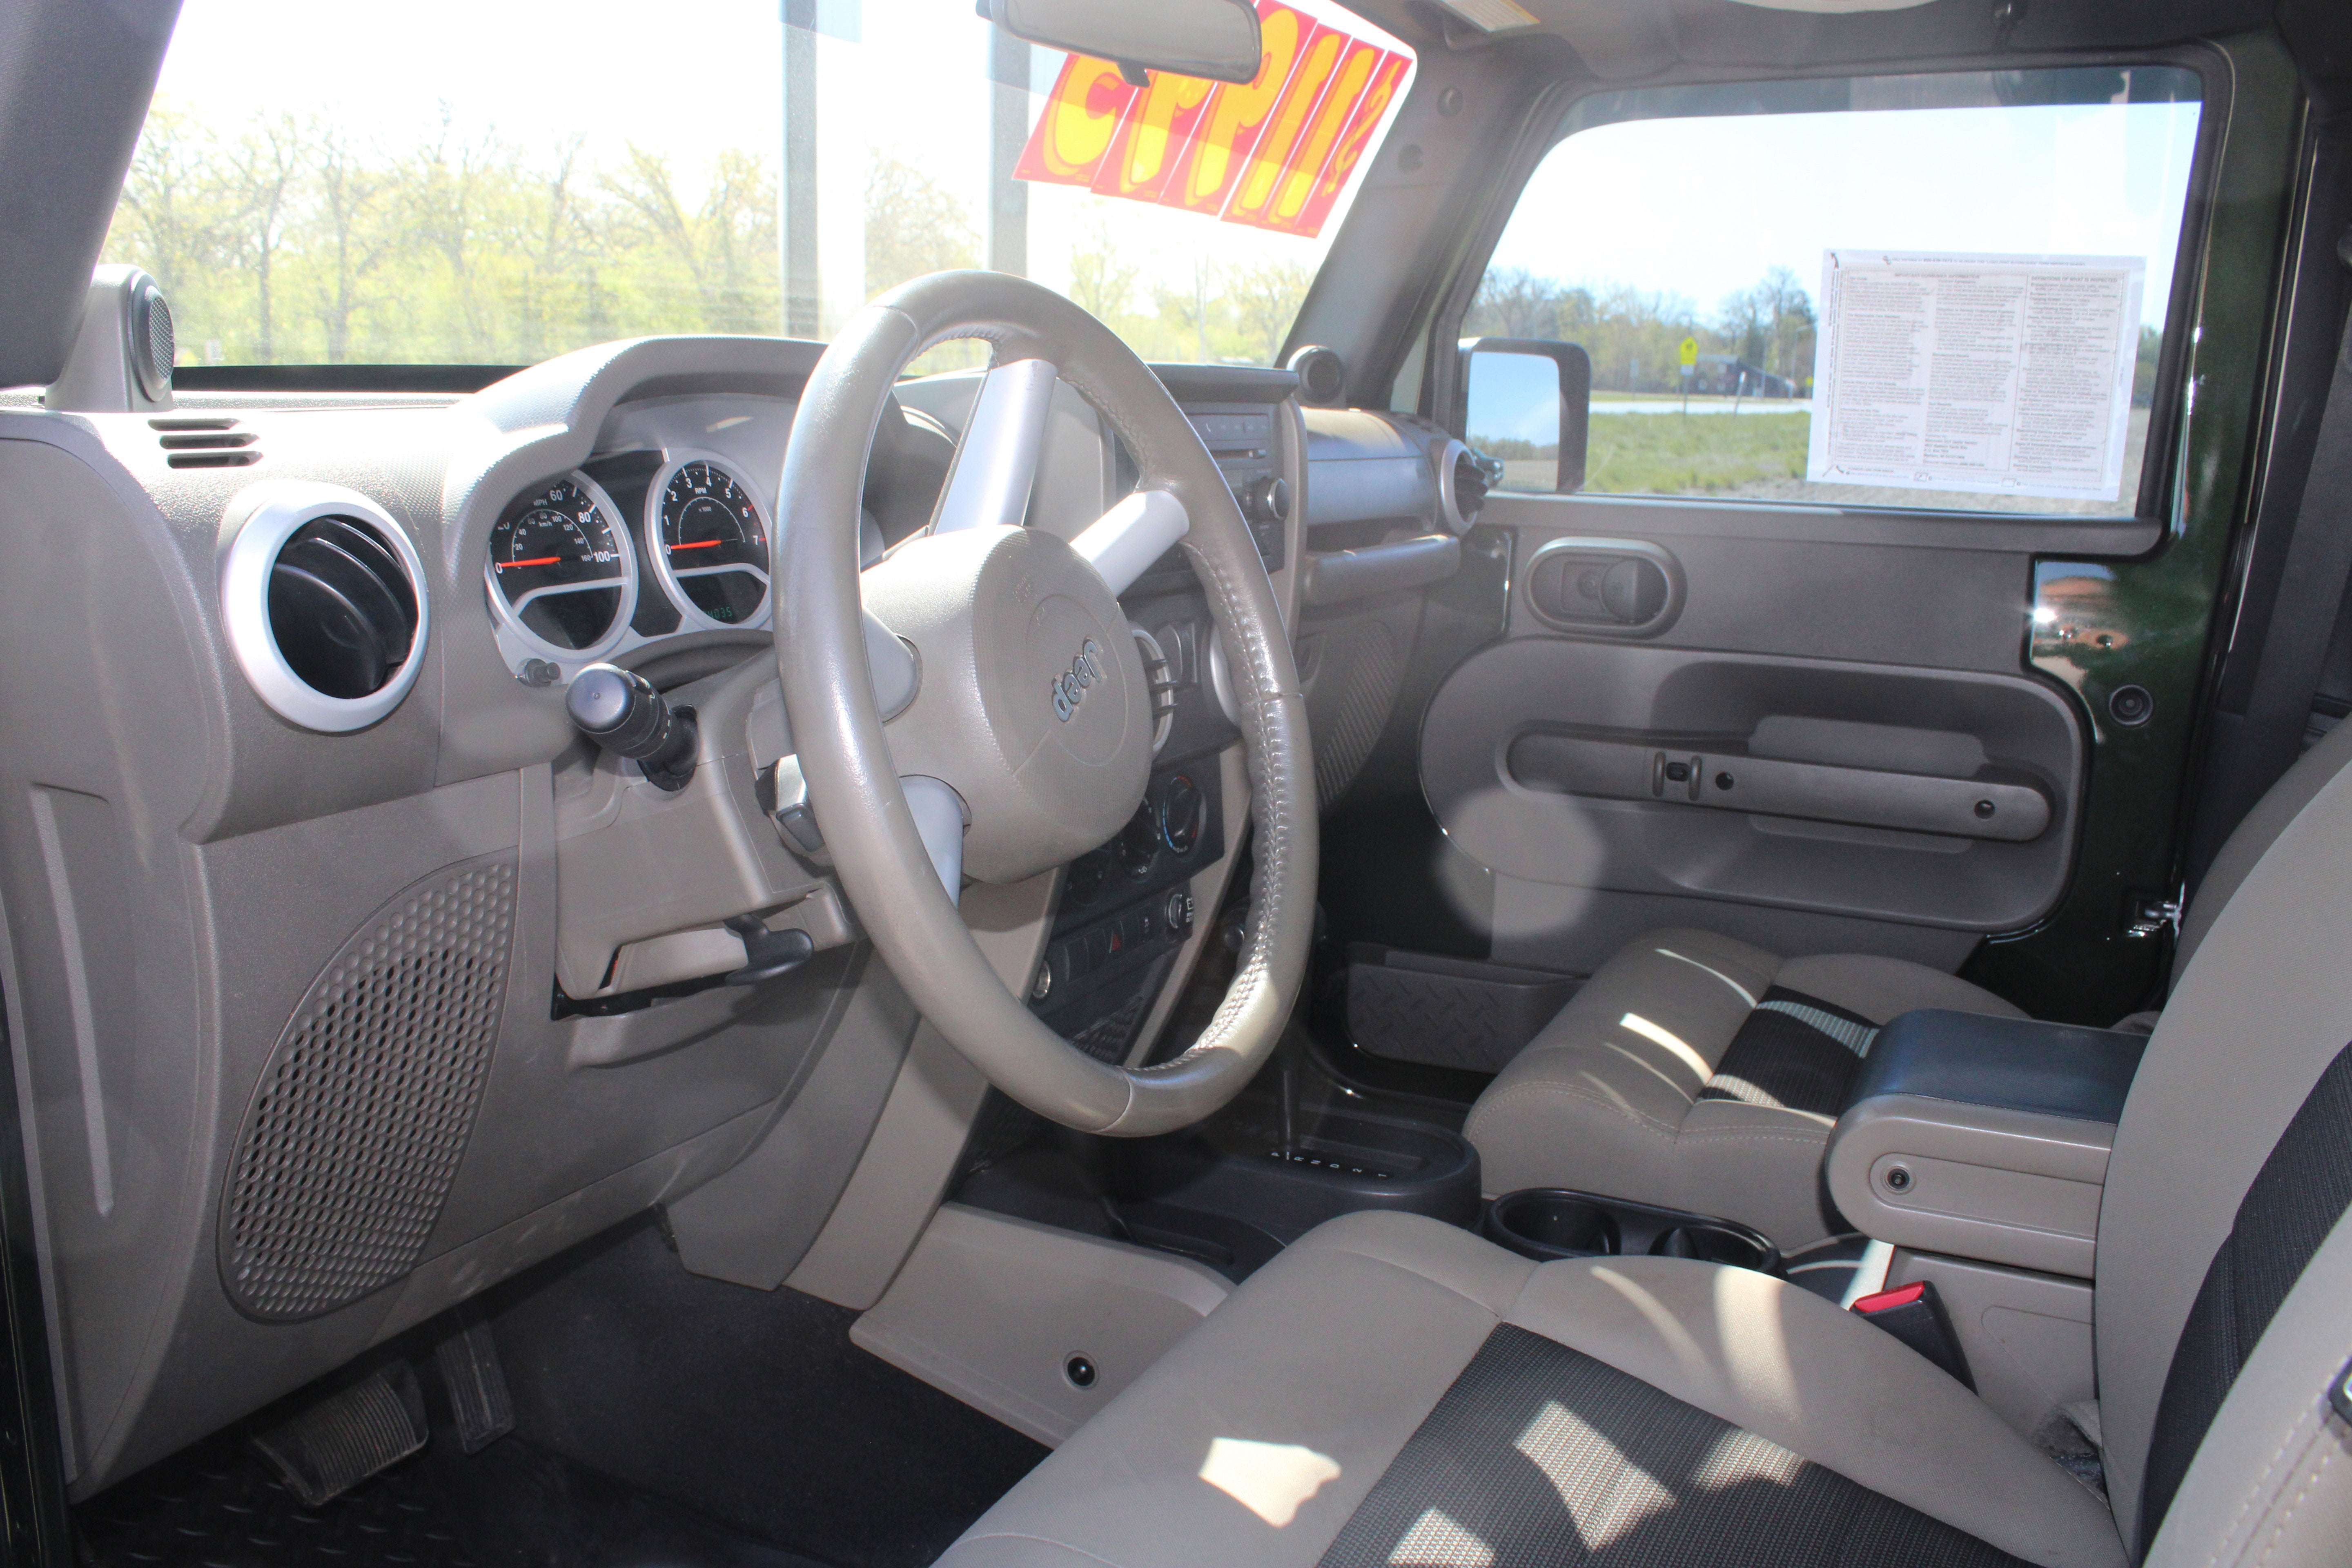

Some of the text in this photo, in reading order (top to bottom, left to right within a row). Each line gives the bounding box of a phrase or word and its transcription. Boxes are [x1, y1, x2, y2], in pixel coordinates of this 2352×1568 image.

[685, 477, 693, 488] 3
[706, 476, 712, 487] 4
[550, 490, 563, 501] 60
[671, 490, 678, 501] 2
[725, 488, 732, 499] 5
[578, 512, 591, 523] 80
[742, 506, 749, 518] 6
[664, 514, 670, 526] 1
[753, 535, 759, 546] 7
[665, 544, 672, 555] 0
[593, 551, 611, 563] 100
[494, 562, 503, 574] 0
[1051, 639, 1102, 722] Jeep
